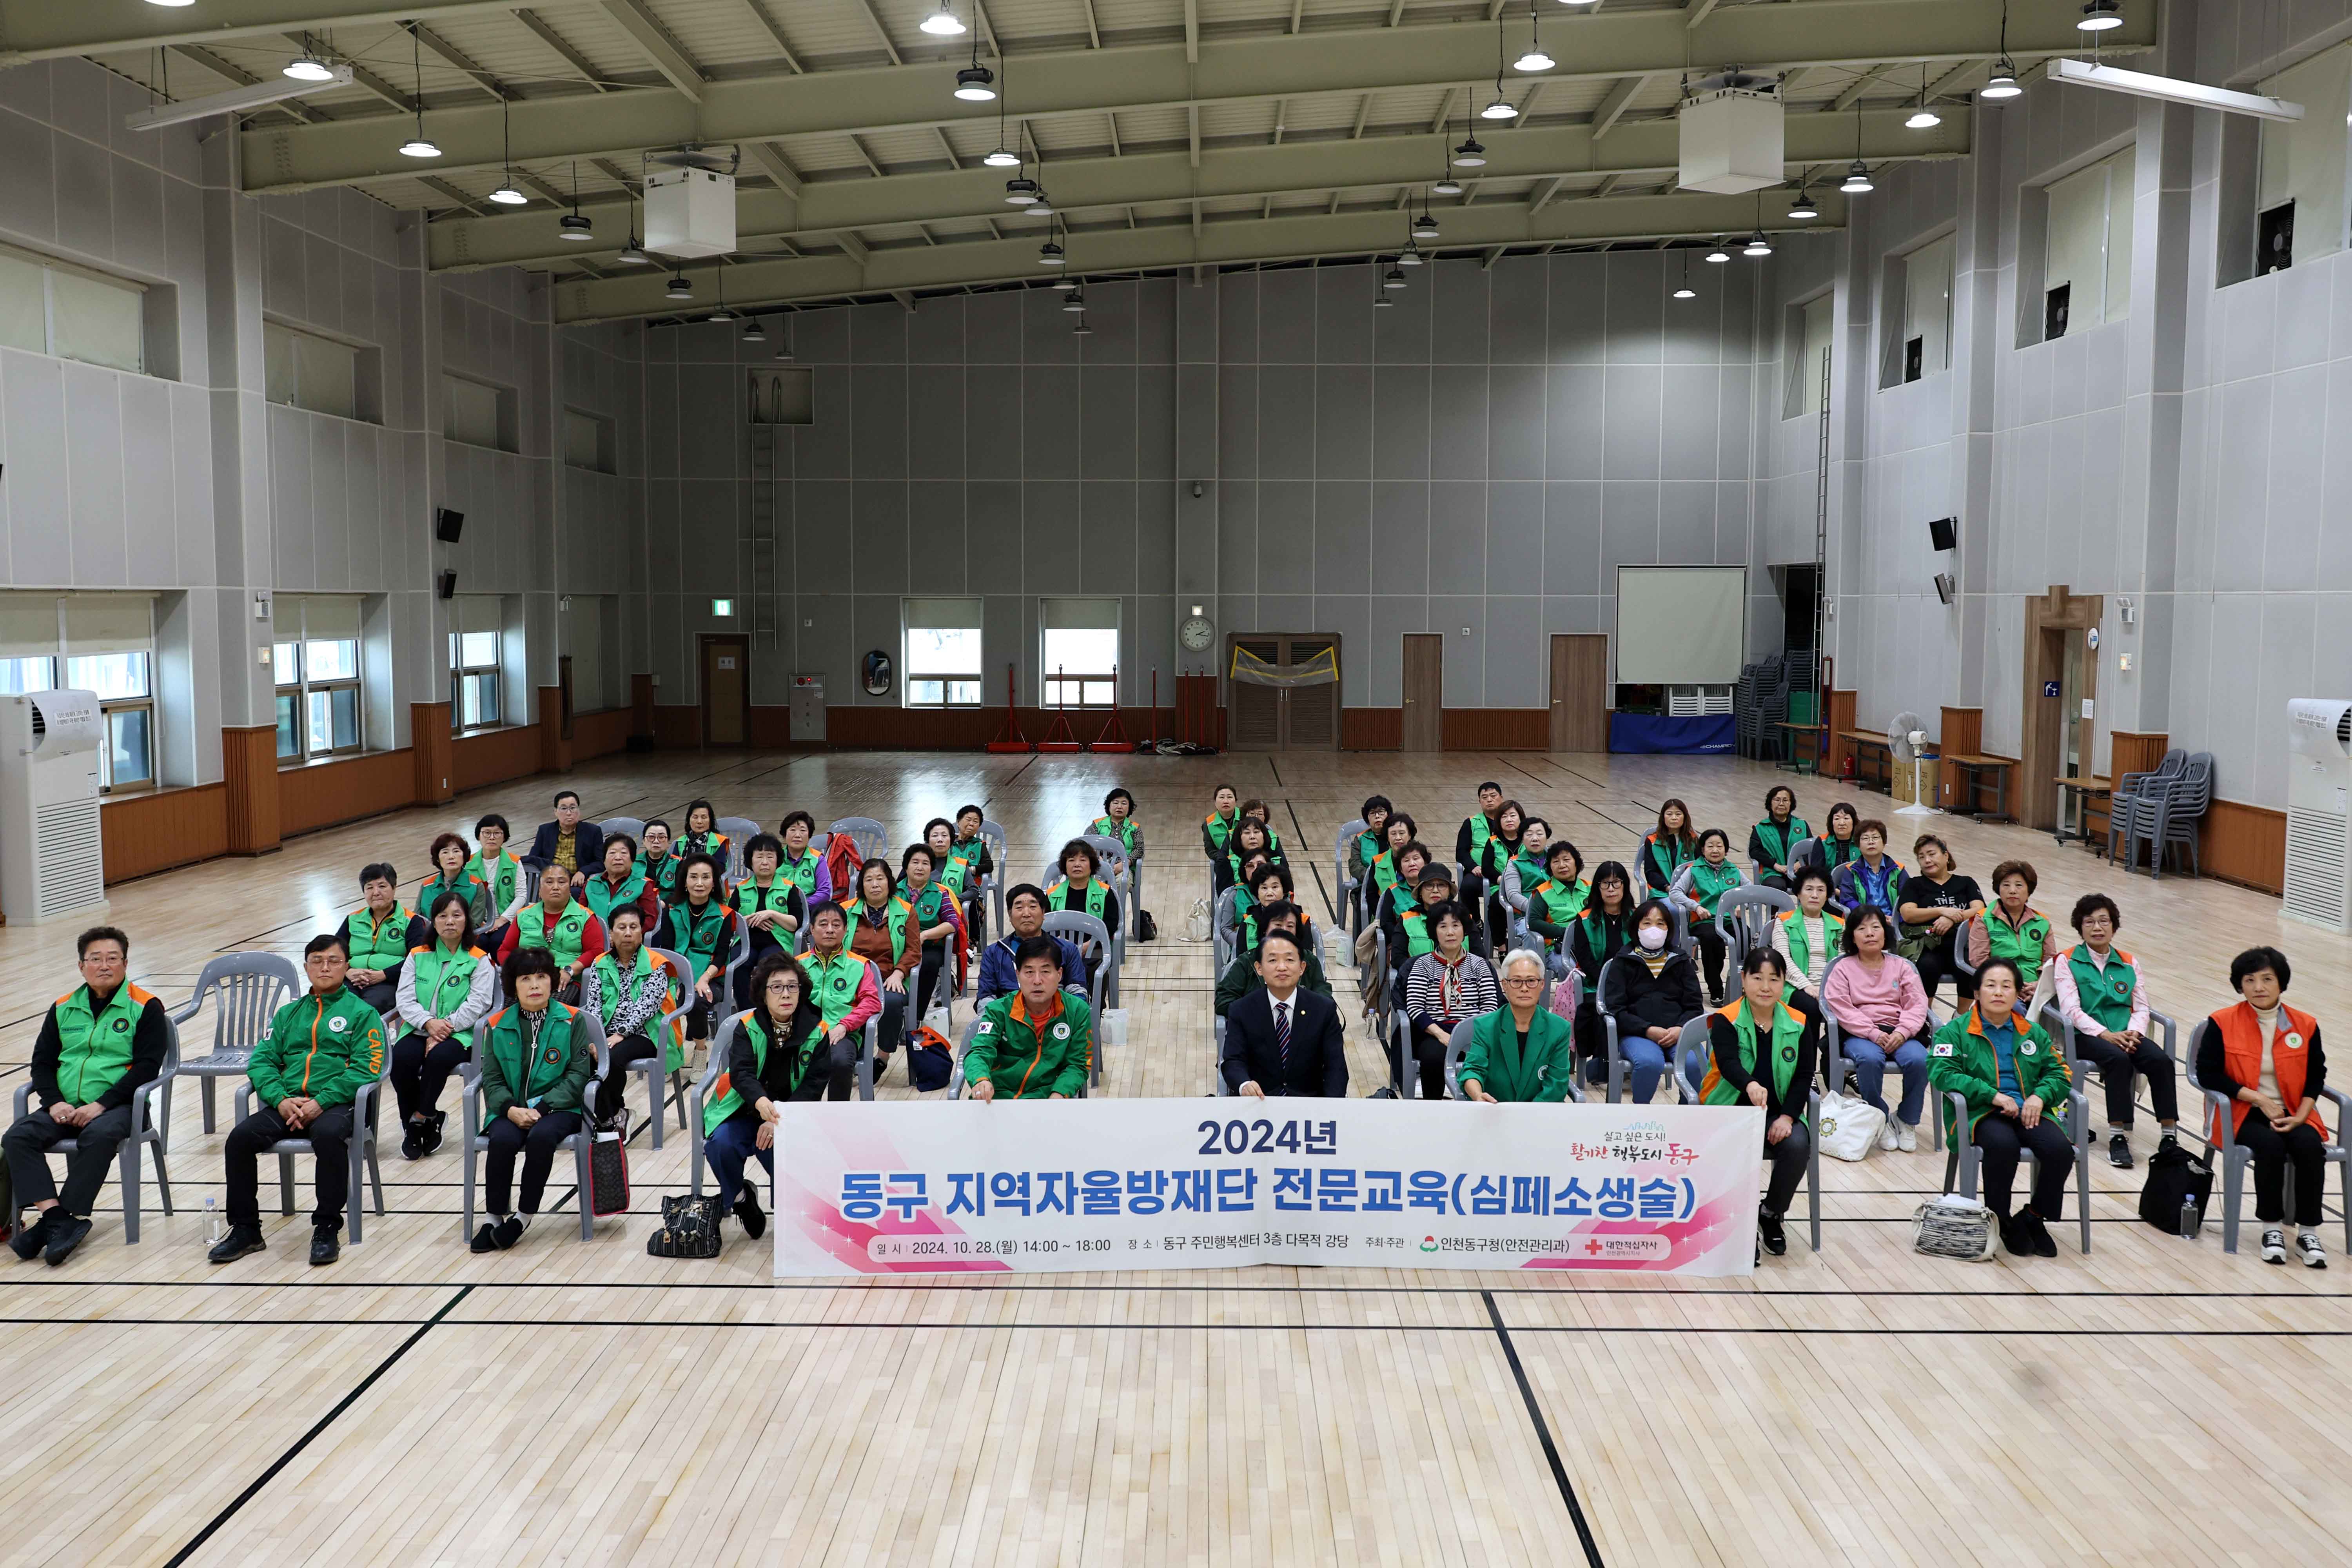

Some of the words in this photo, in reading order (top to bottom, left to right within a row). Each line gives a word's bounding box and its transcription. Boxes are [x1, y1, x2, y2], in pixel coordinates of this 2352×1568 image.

[1935, 897, 1955, 905] THE
[1198, 1119, 1337, 1155] 2024년
[1604, 1131, 1622, 1142] 살고
[1625, 1132, 1642, 1142] 싶은
[1644, 1132, 1666, 1142] 도시!
[1570, 1142, 1609, 1161] 활기찬
[1612, 1145, 1662, 1163] 행복도시
[1664, 1143, 1699, 1165] 동구
[842, 1173, 928, 1219] 동구
[946, 1168, 1258, 1217] 지역자율방재단
[1273, 1168, 1695, 1219] 전문교육(심페소생술)
[877, 1243, 886, 1255] 일
[892, 1243, 901, 1254] 시
[913, 1241, 948, 1254] 2024.
[953, 1241, 971, 1254] 10.
[976, 1240, 1018, 1255] 28.(월)
[1023, 1240, 1058, 1252] 14:00
[1076, 1239, 1111, 1252] 18:00
[1128, 1239, 1138, 1250] 장
[1143, 1239, 1152, 1249] 소
[1163, 1236, 1187, 1250] 동구
[1191, 1233, 1259, 1249] 주민행복센터
[1263, 1232, 1282, 1246] 3층
[1286, 1233, 1321, 1247] 다목적
[1325, 1234, 1349, 1248] 강당
[1365, 1237, 1405, 1248] 주최·주관
[1441, 1237, 1570, 1253] 인천동구청(안전관리과)
[1606, 1240, 1657, 1250] 대한적십자사
